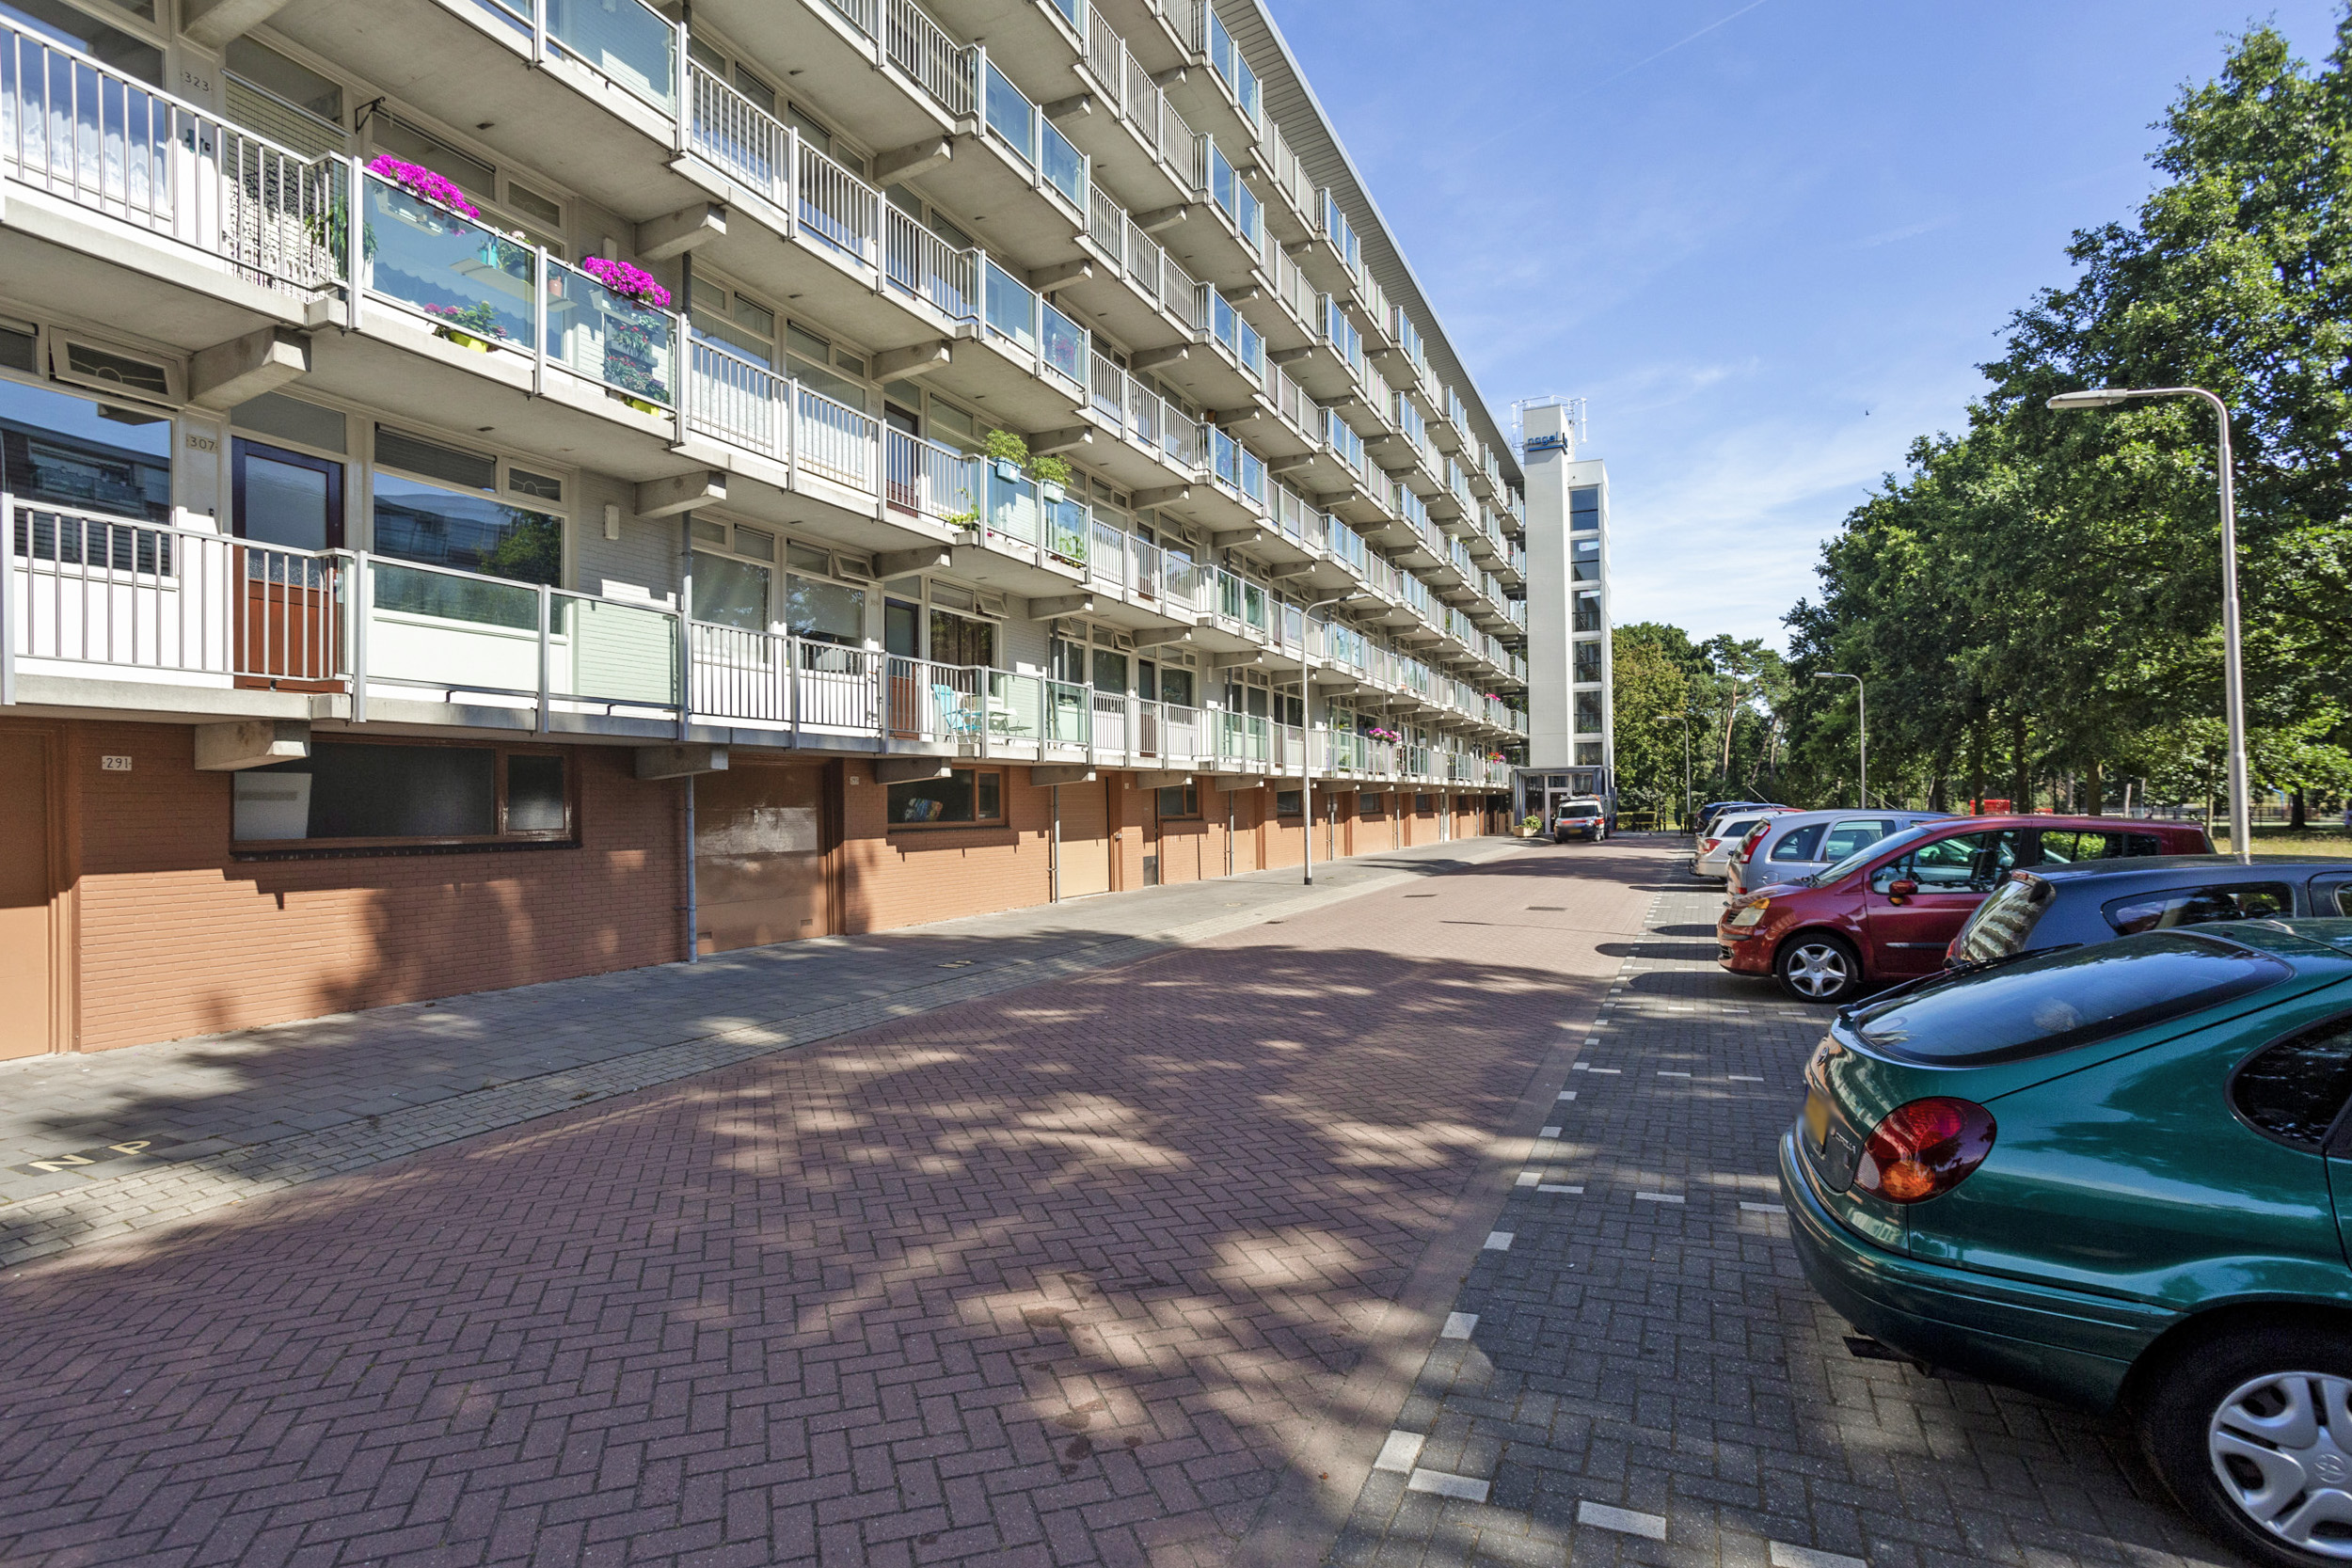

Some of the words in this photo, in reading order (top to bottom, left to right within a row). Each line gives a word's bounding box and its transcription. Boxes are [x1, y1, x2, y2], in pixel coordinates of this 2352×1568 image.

[184, 71, 210, 92] 323
[190, 436, 215, 451] 307
[1527, 431, 1559, 446] nagel
[106, 757, 128, 768] 291
